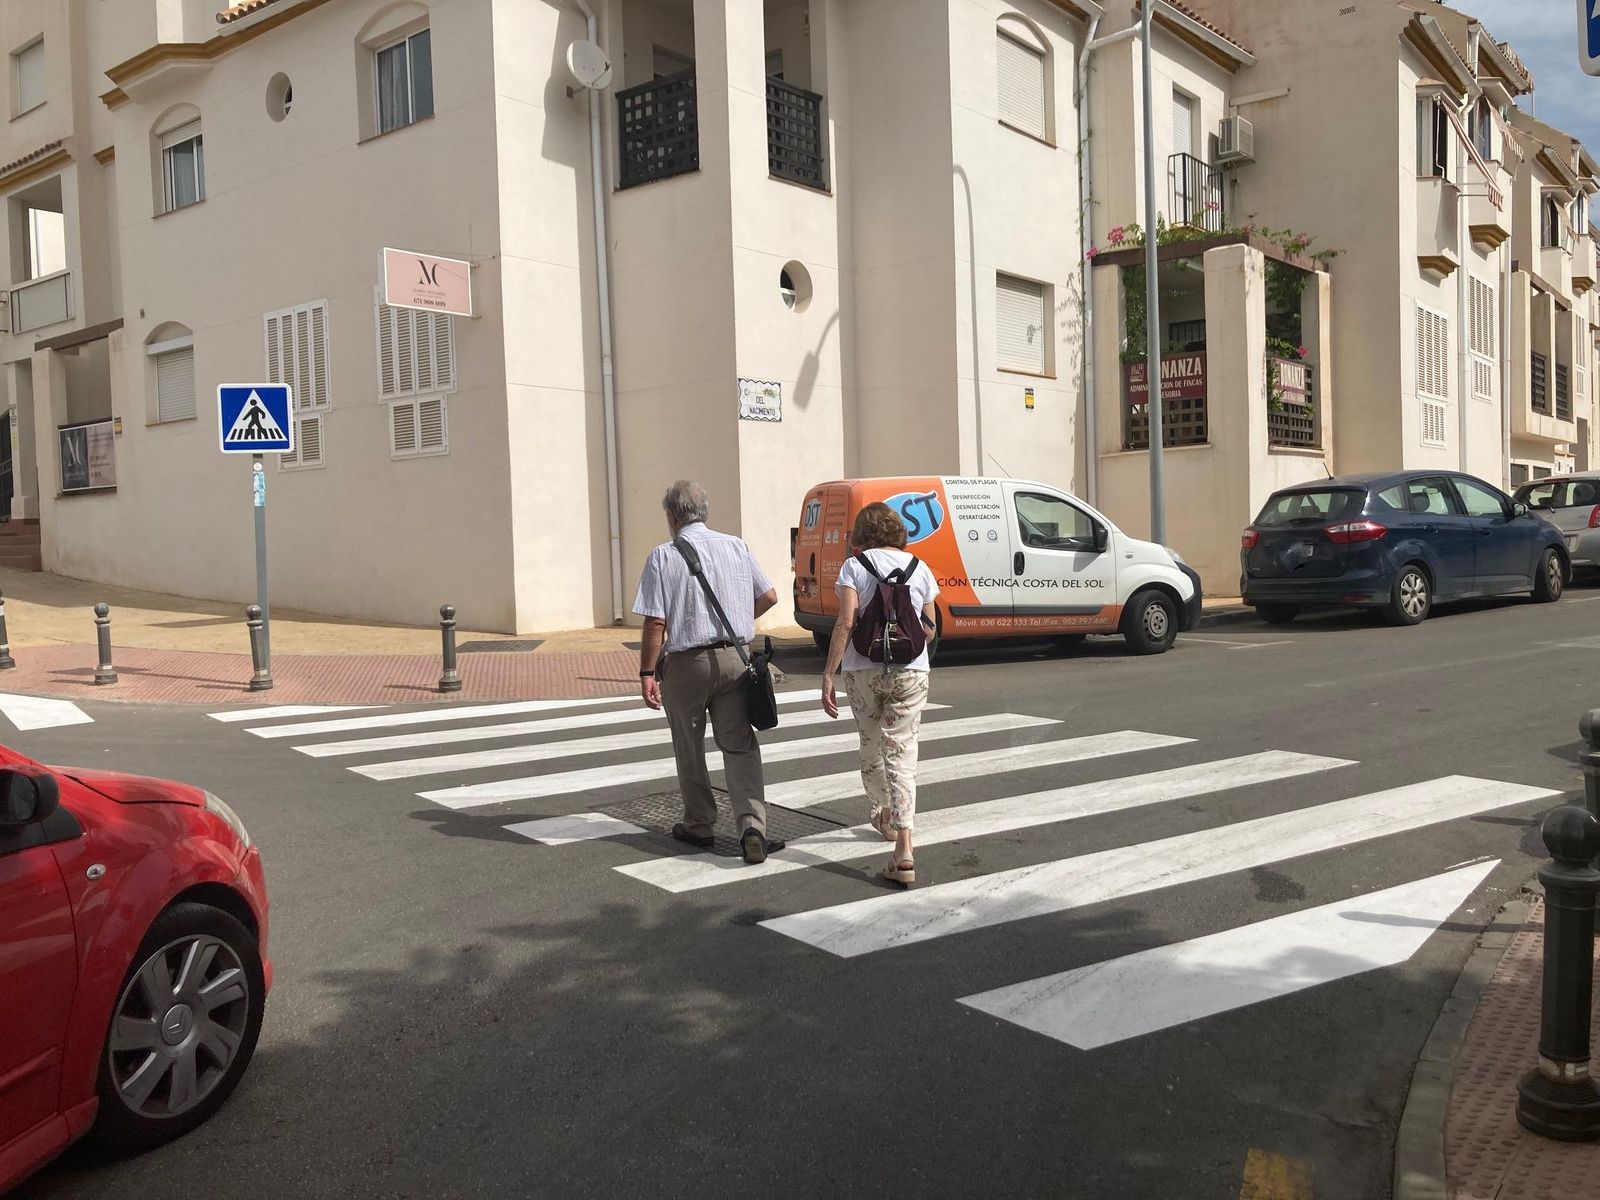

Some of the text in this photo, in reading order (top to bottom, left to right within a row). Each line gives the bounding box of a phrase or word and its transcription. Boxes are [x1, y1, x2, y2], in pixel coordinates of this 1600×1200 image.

[1161, 357, 1203, 379] NANZA
[1174, 380, 1182, 388] DE
[1183, 378, 1203, 387] FINCAS
[1161, 389, 1181, 399] ESORIA
[755, 396, 765, 404] DEL
[901, 491, 937, 538] ST
[937, 576, 1104, 588] CIÓN TÉCNICA COSTA DEL SOL
[980, 618, 995, 626] 636
[997, 618, 1012, 627] 622
